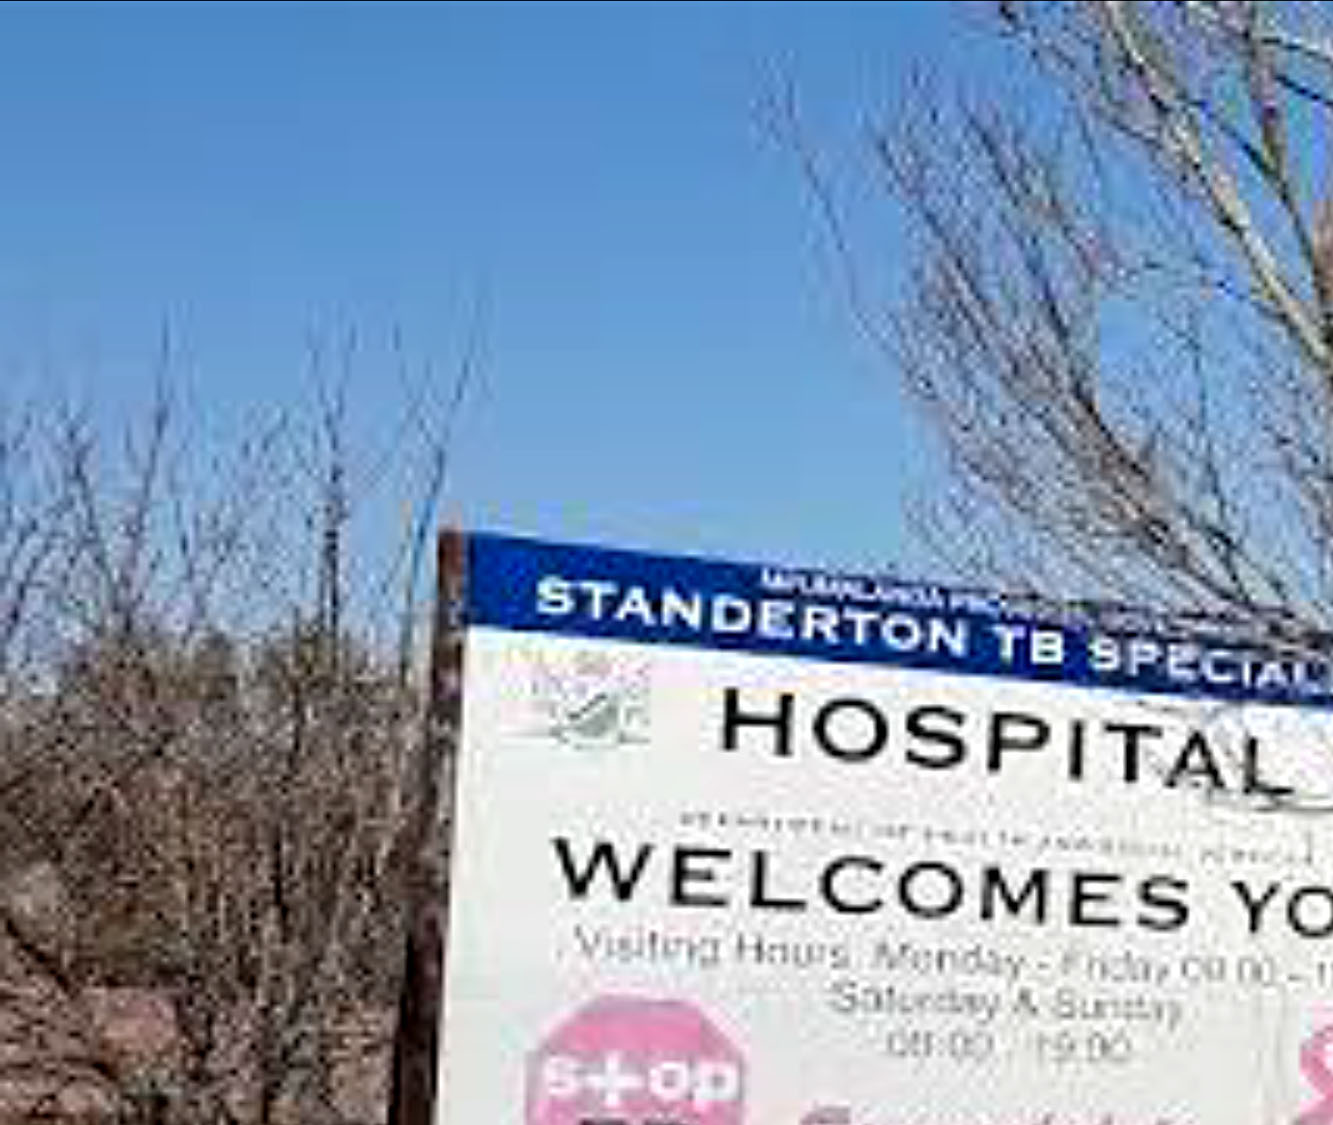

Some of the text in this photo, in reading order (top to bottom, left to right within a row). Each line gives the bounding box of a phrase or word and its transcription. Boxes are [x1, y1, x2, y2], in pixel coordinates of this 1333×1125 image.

[535, 574, 967, 657] STANDERTON
[994, 624, 1066, 667] TB
[721, 686, 1296, 796] HOSPITAL
[551, 837, 1189, 931] WELCOMES
[573, 924, 721, 970] Visiting
[874, 941, 1025, 984] Monday
[830, 980, 1001, 1021] Saturday
[1055, 989, 1183, 1031] Sunday
